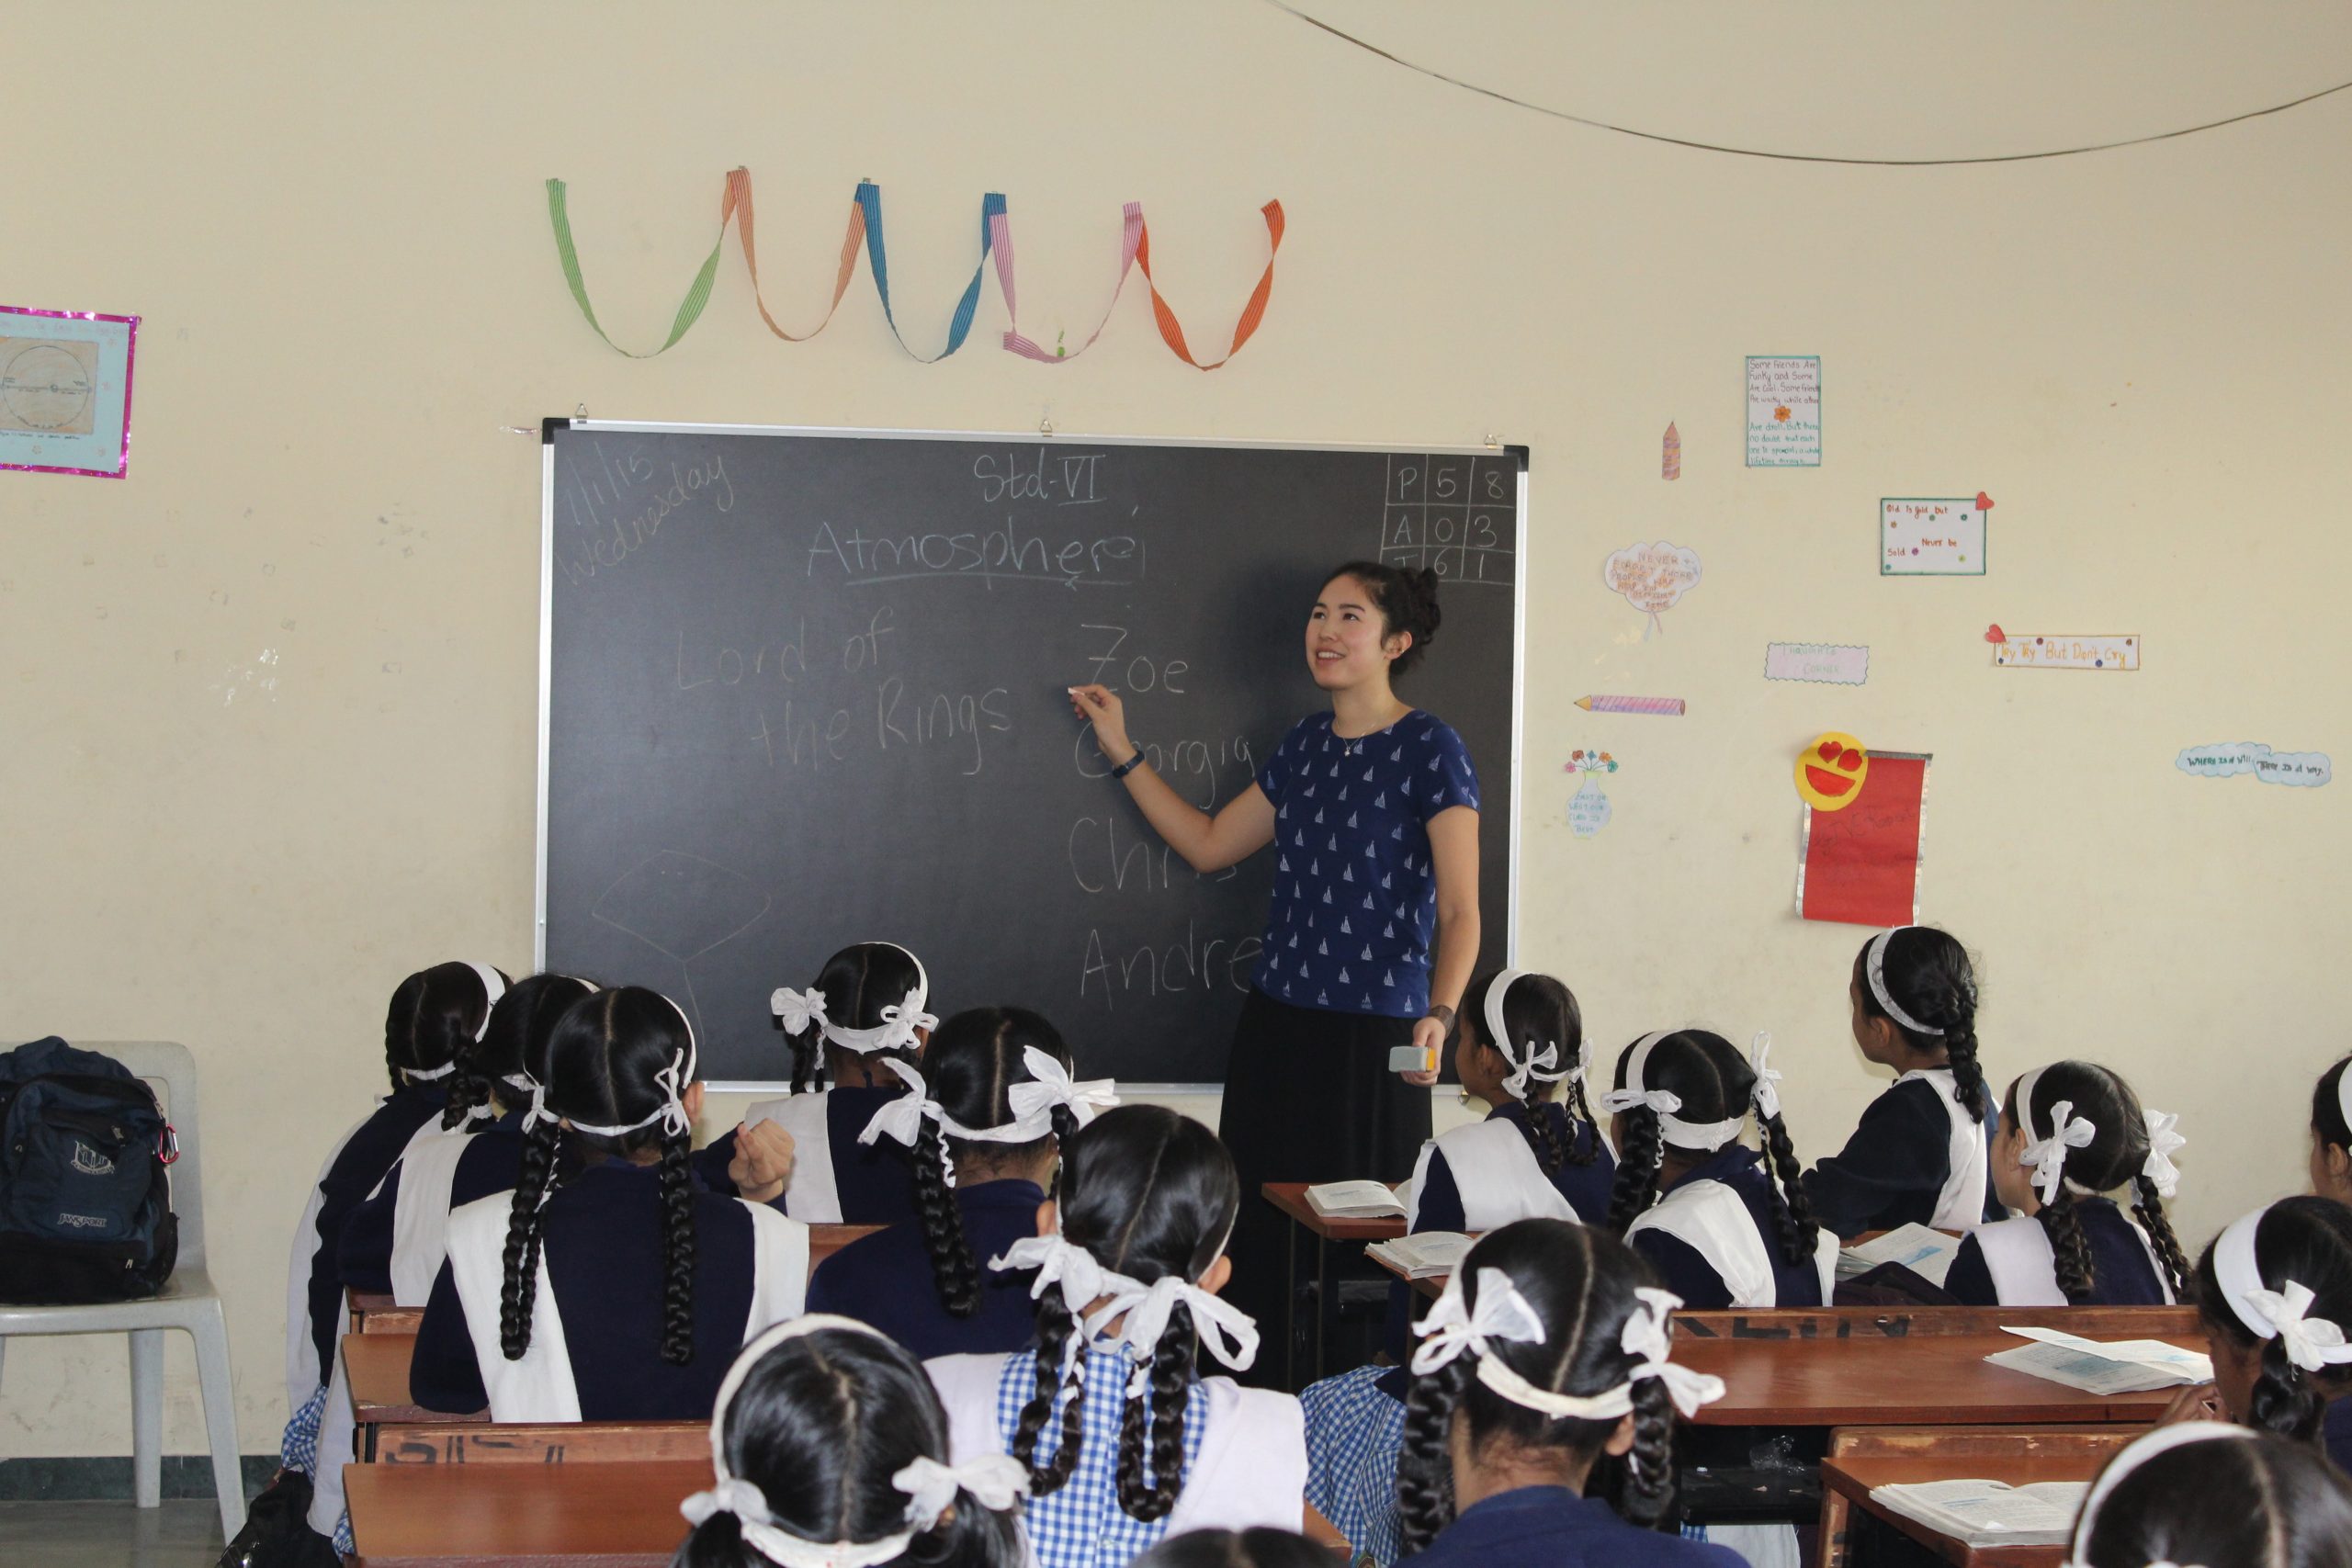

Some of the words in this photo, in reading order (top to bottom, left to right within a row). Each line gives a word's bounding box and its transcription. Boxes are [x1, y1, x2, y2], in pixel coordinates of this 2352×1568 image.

[1774, 371, 1788, 380] and
[1792, 371, 1812, 380] Some
[1397, 468, 1419, 501] P
[1436, 468, 1456, 500] 5
[1486, 470, 1505, 498] 8
[1393, 514, 1413, 545] A
[1434, 516, 1454, 545] 0
[1474, 514, 1498, 550] 3
[1433, 547, 1449, 575] 6
[678, 615, 808, 691] Lord
[843, 605, 895, 673] of
[2045, 640, 2066, 660] But
[752, 700, 851, 770] the
[877, 678, 1010, 776] Rings
